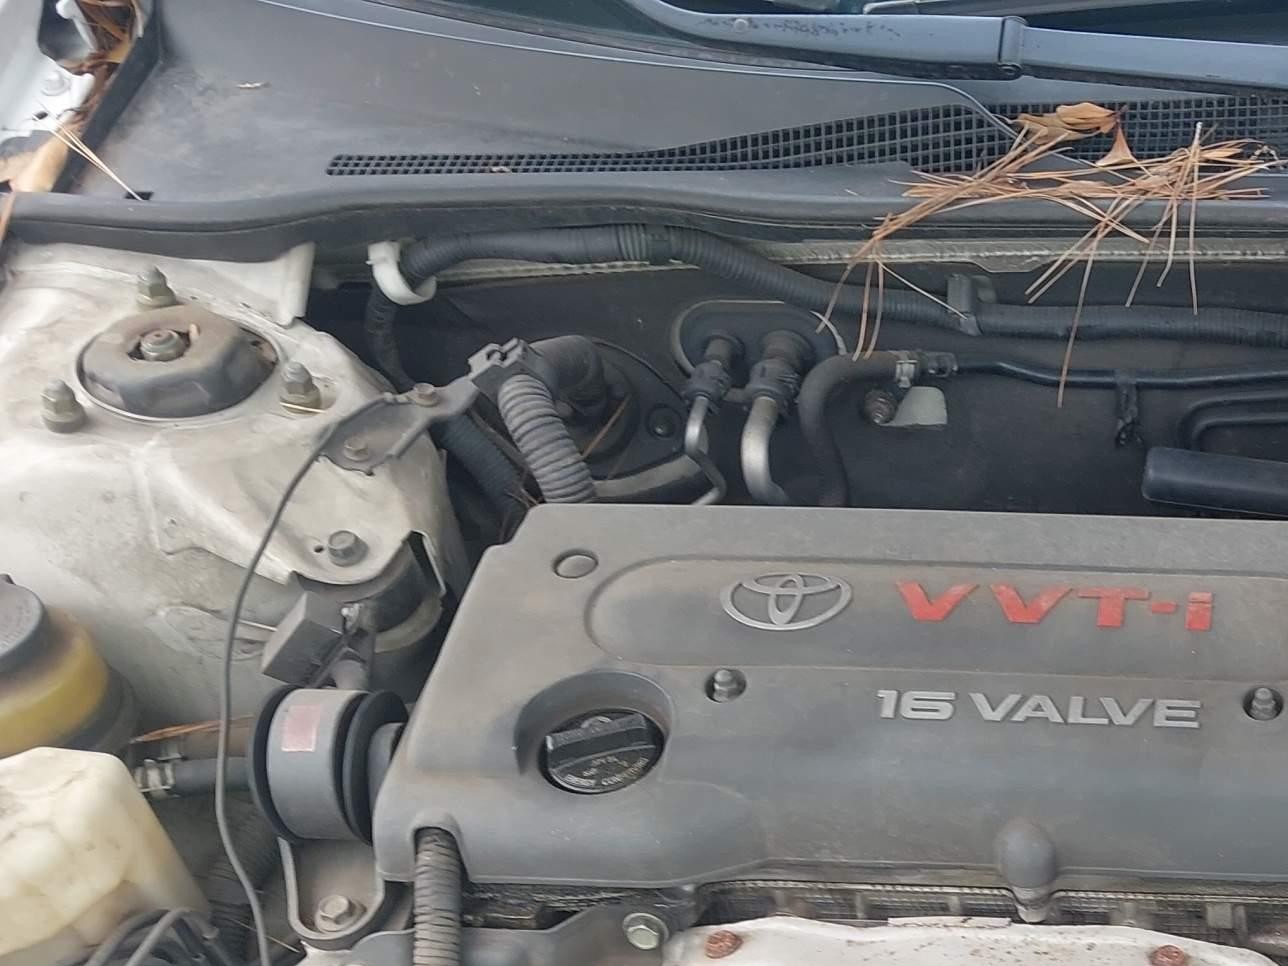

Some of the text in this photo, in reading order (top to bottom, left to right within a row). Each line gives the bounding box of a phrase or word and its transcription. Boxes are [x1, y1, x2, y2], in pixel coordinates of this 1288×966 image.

[896, 581, 1213, 632] VVT-i
[876, 689, 1203, 728] 16 VALVE
